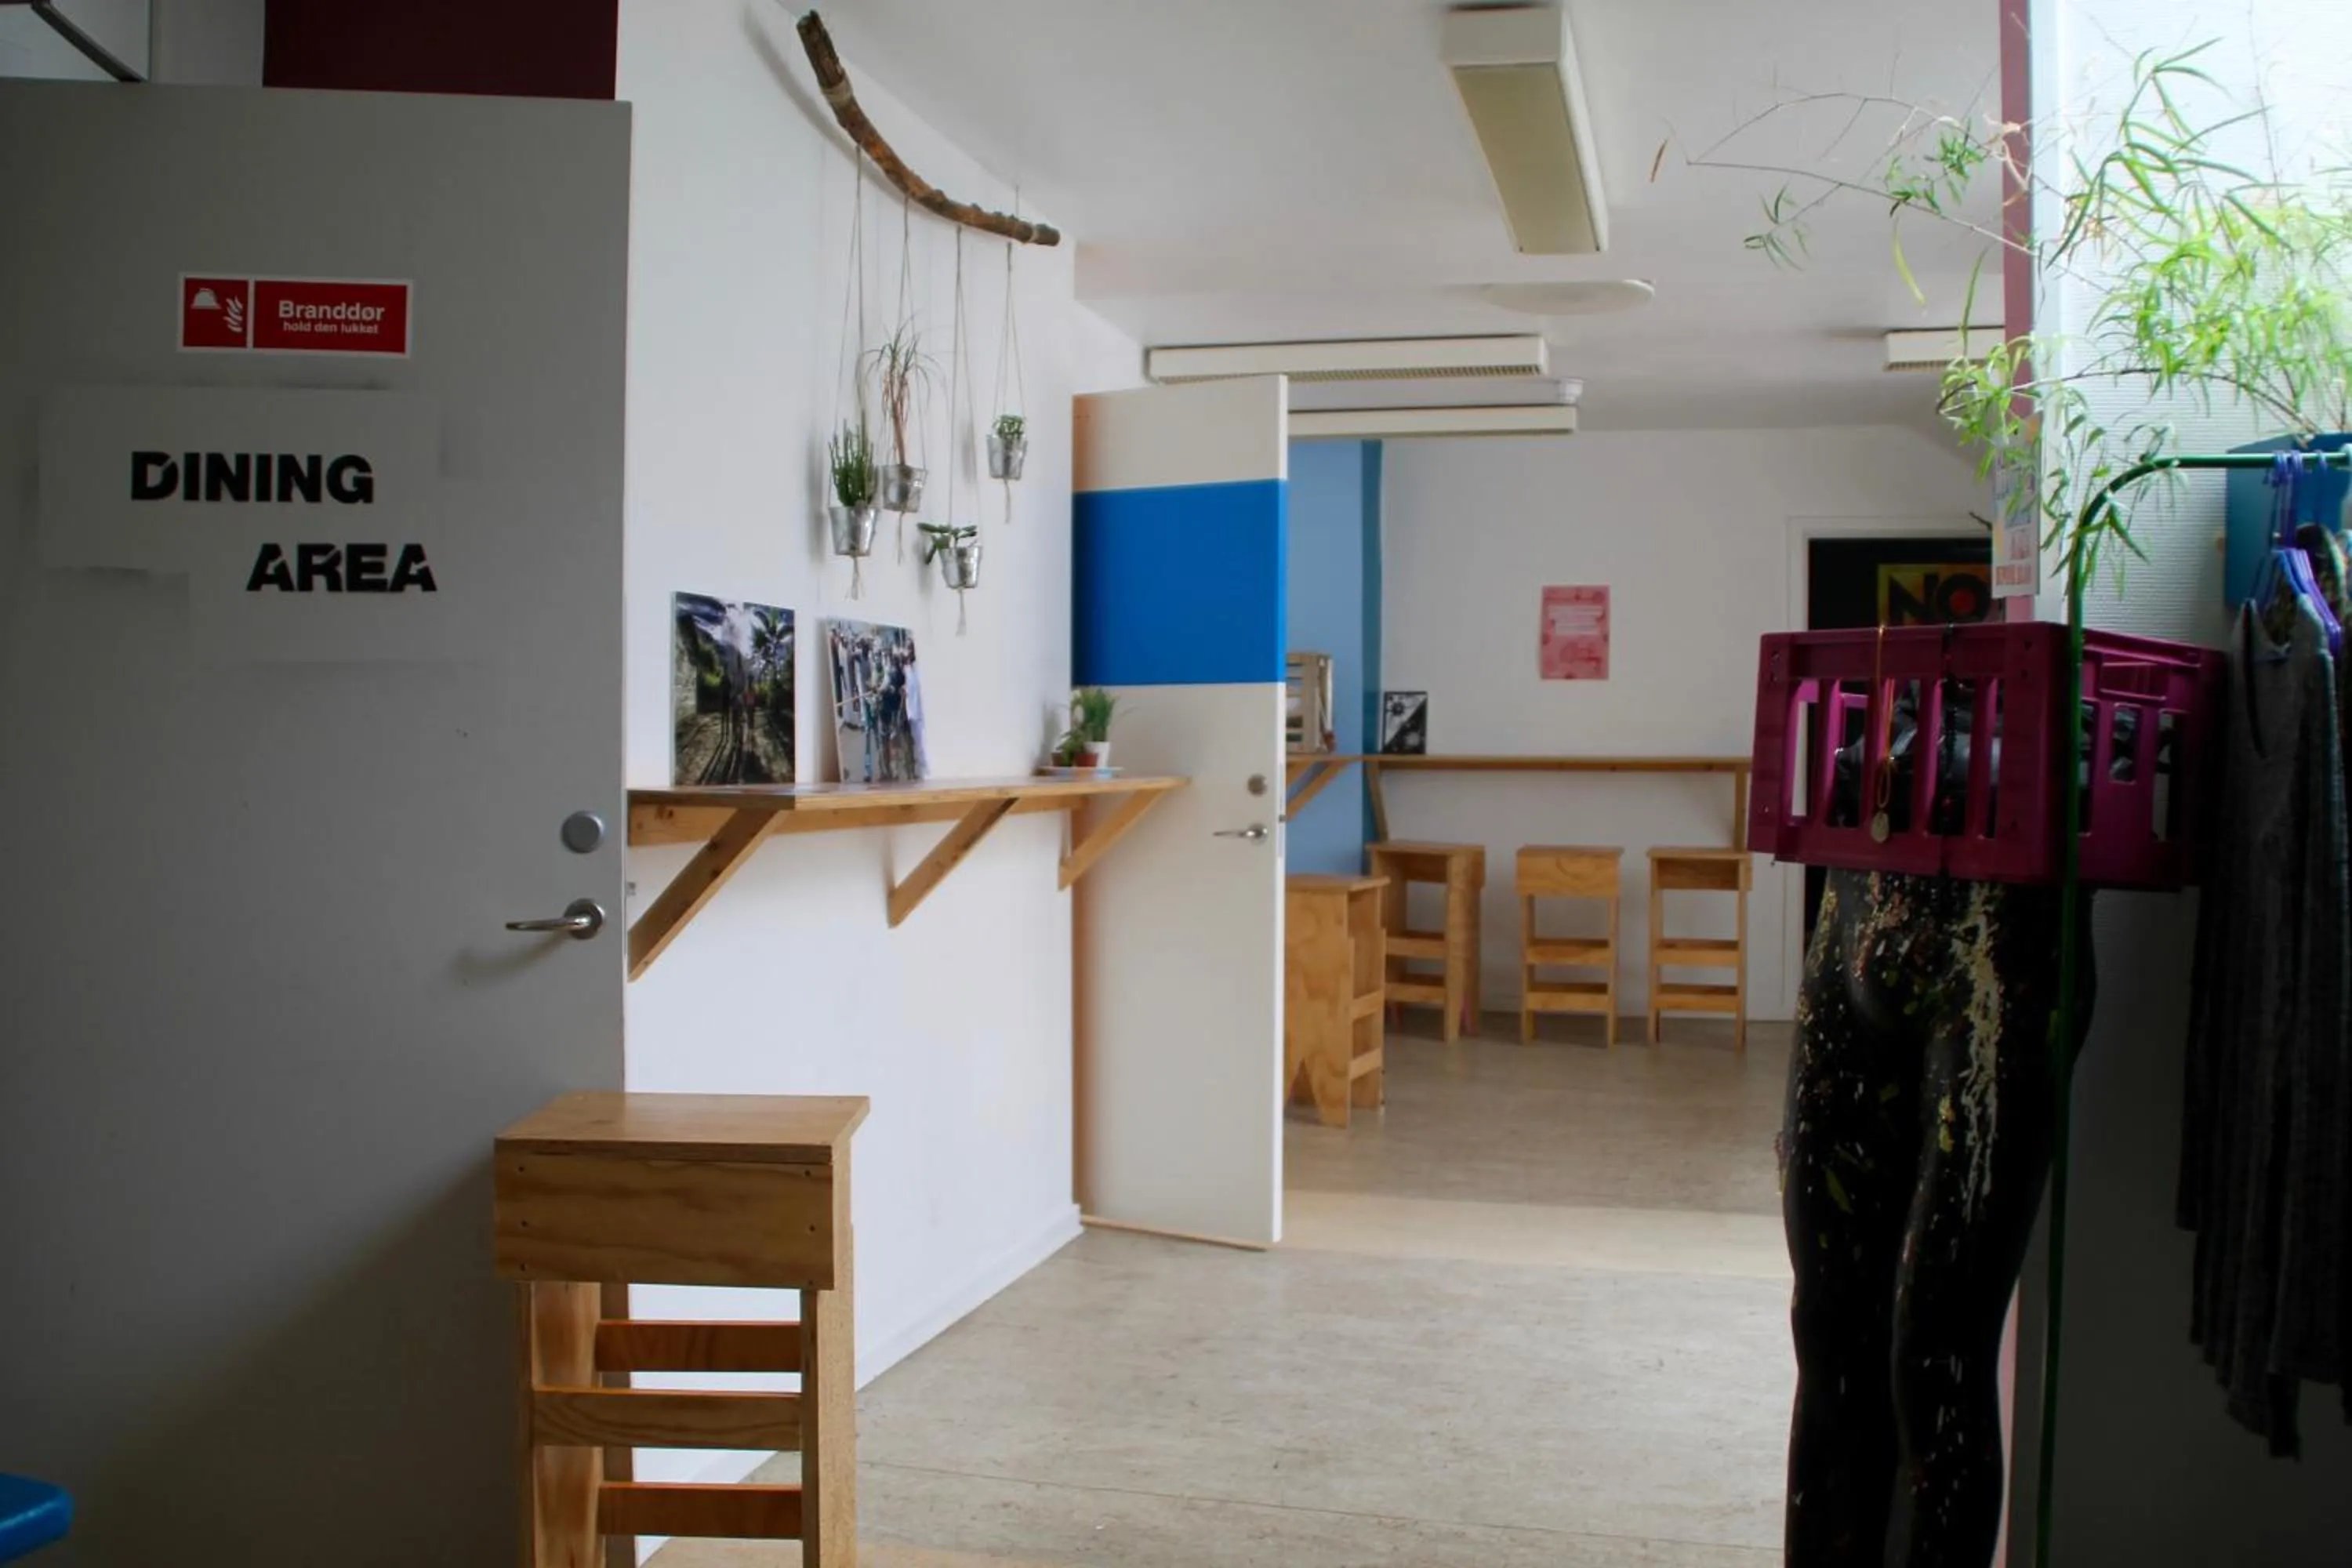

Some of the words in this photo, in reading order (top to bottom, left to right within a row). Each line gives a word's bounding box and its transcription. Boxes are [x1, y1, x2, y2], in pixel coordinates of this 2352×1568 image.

[283, 321, 311, 332] hold
[314, 321, 337, 332] den
[341, 322, 379, 334] lukket
[130, 451, 374, 503] DINING
[245, 543, 437, 593] AREA
